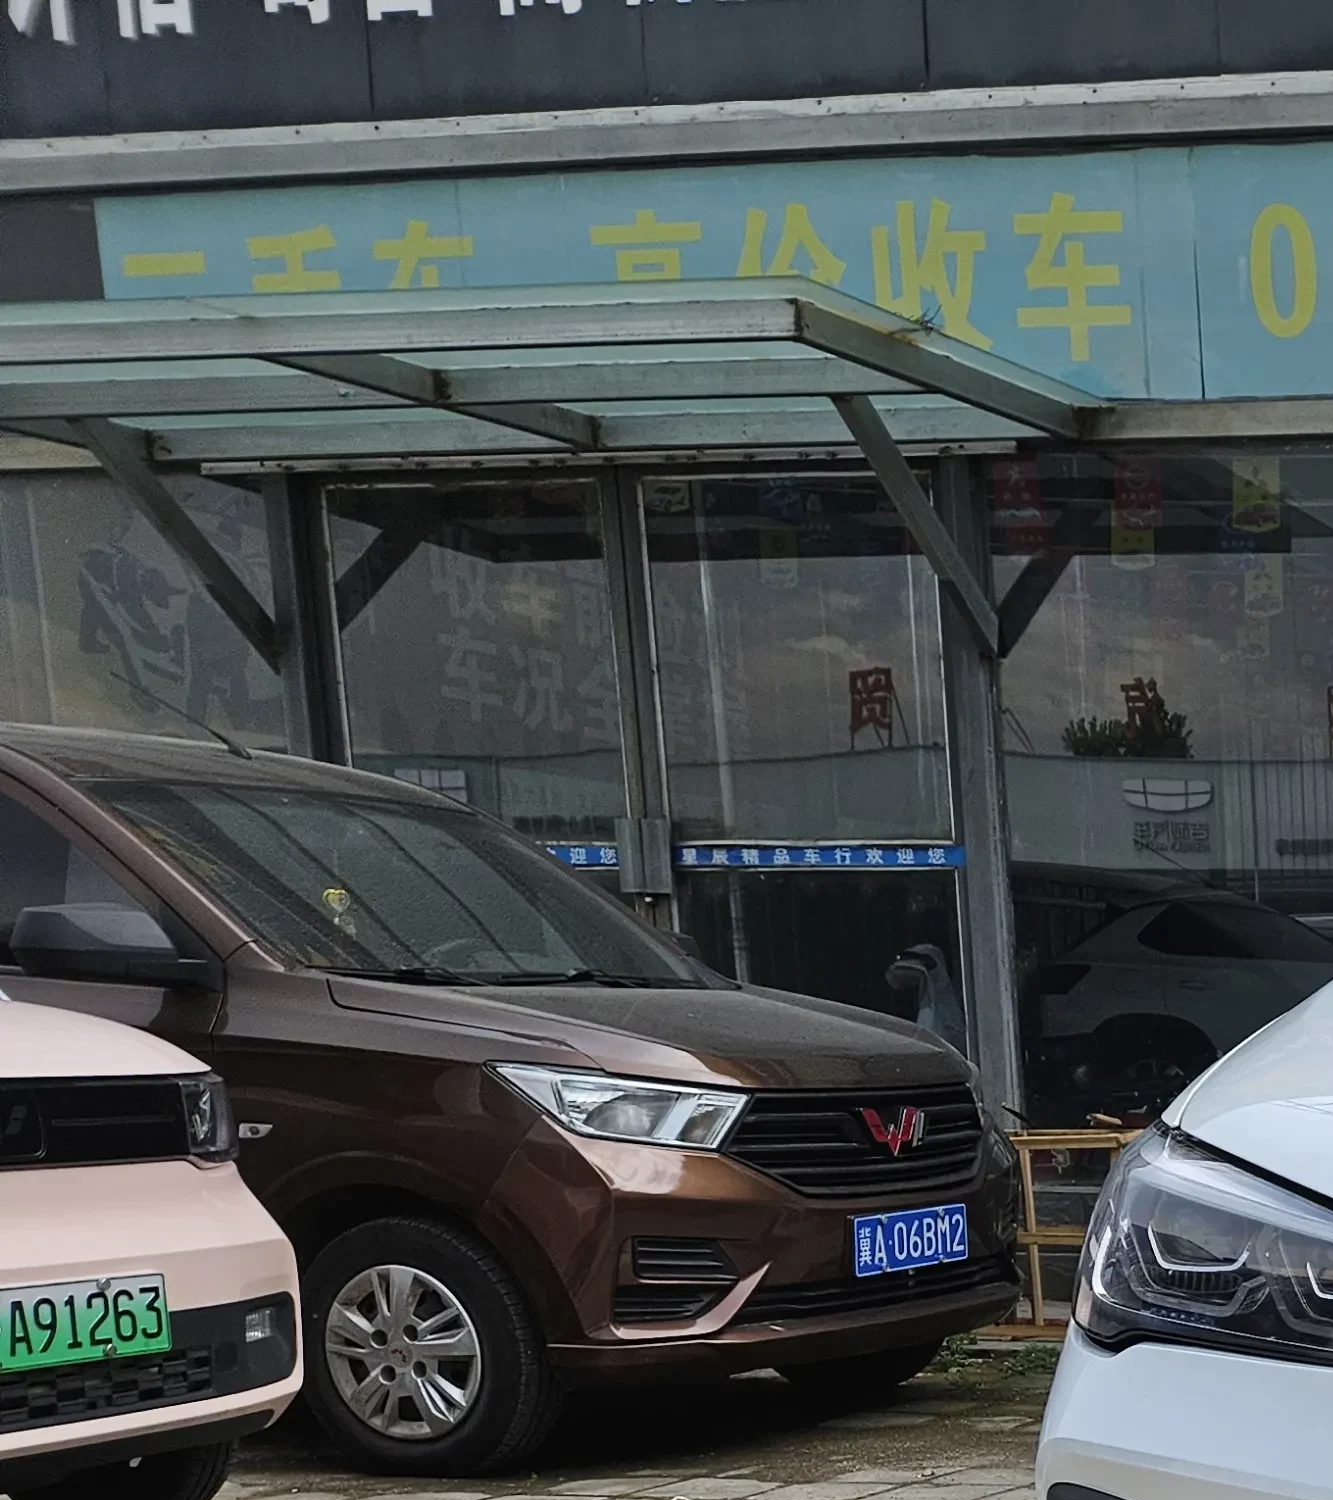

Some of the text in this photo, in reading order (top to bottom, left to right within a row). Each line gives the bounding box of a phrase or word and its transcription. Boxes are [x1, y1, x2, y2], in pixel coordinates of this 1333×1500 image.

[547, 846, 618, 866] 迎您
[681, 846, 948, 866] 星辰精品车行欢迎您
[9, 1285, 164, 1358] A91263
